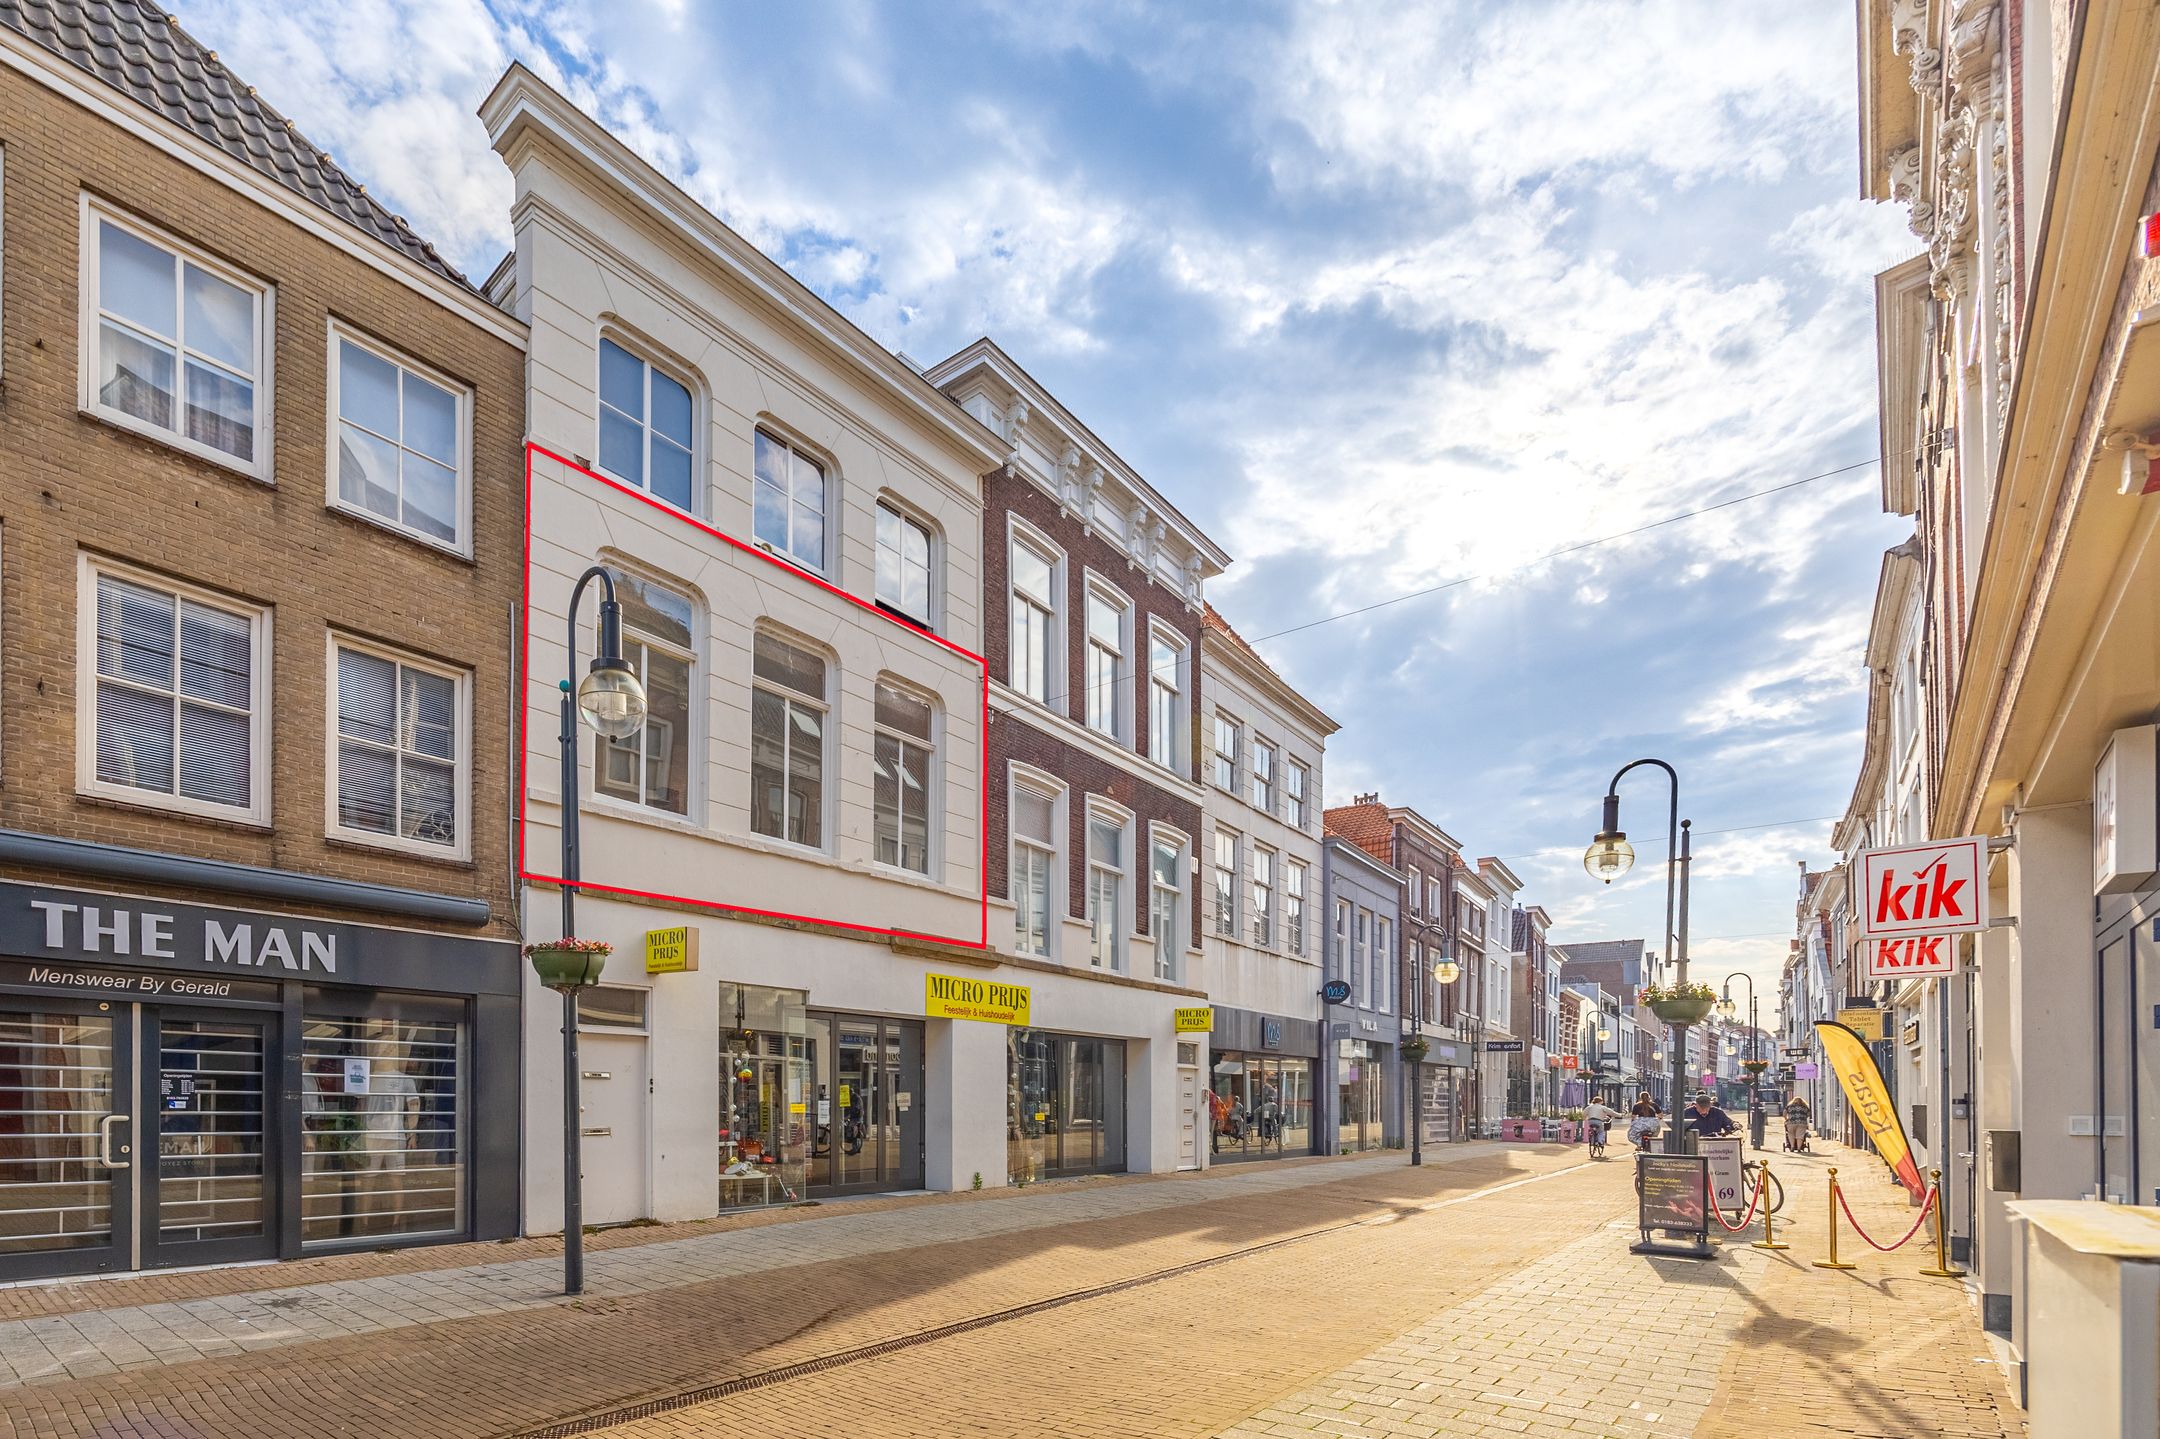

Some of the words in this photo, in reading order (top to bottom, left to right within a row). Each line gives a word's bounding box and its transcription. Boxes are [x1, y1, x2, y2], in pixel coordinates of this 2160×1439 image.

[31, 900, 175, 958] THE
[205, 919, 336, 973] MAN
[649, 930, 684, 947] MICRO
[653, 946, 679, 960] PRIJS
[28, 967, 135, 989] Menswear
[139, 976, 165, 994] By
[171, 978, 230, 996] Gerald
[930, 976, 984, 1003] MICRO
[988, 984, 1028, 1011] PRIJS
[944, 1004, 971, 1018] Feestelijk
[972, 1007, 978, 1016] &
[978, 1008, 1016, 1022] Huishoudelijk
[1178, 1010, 1209, 1018] MICRO
[1181, 1018, 1205, 1026] PRIJS
